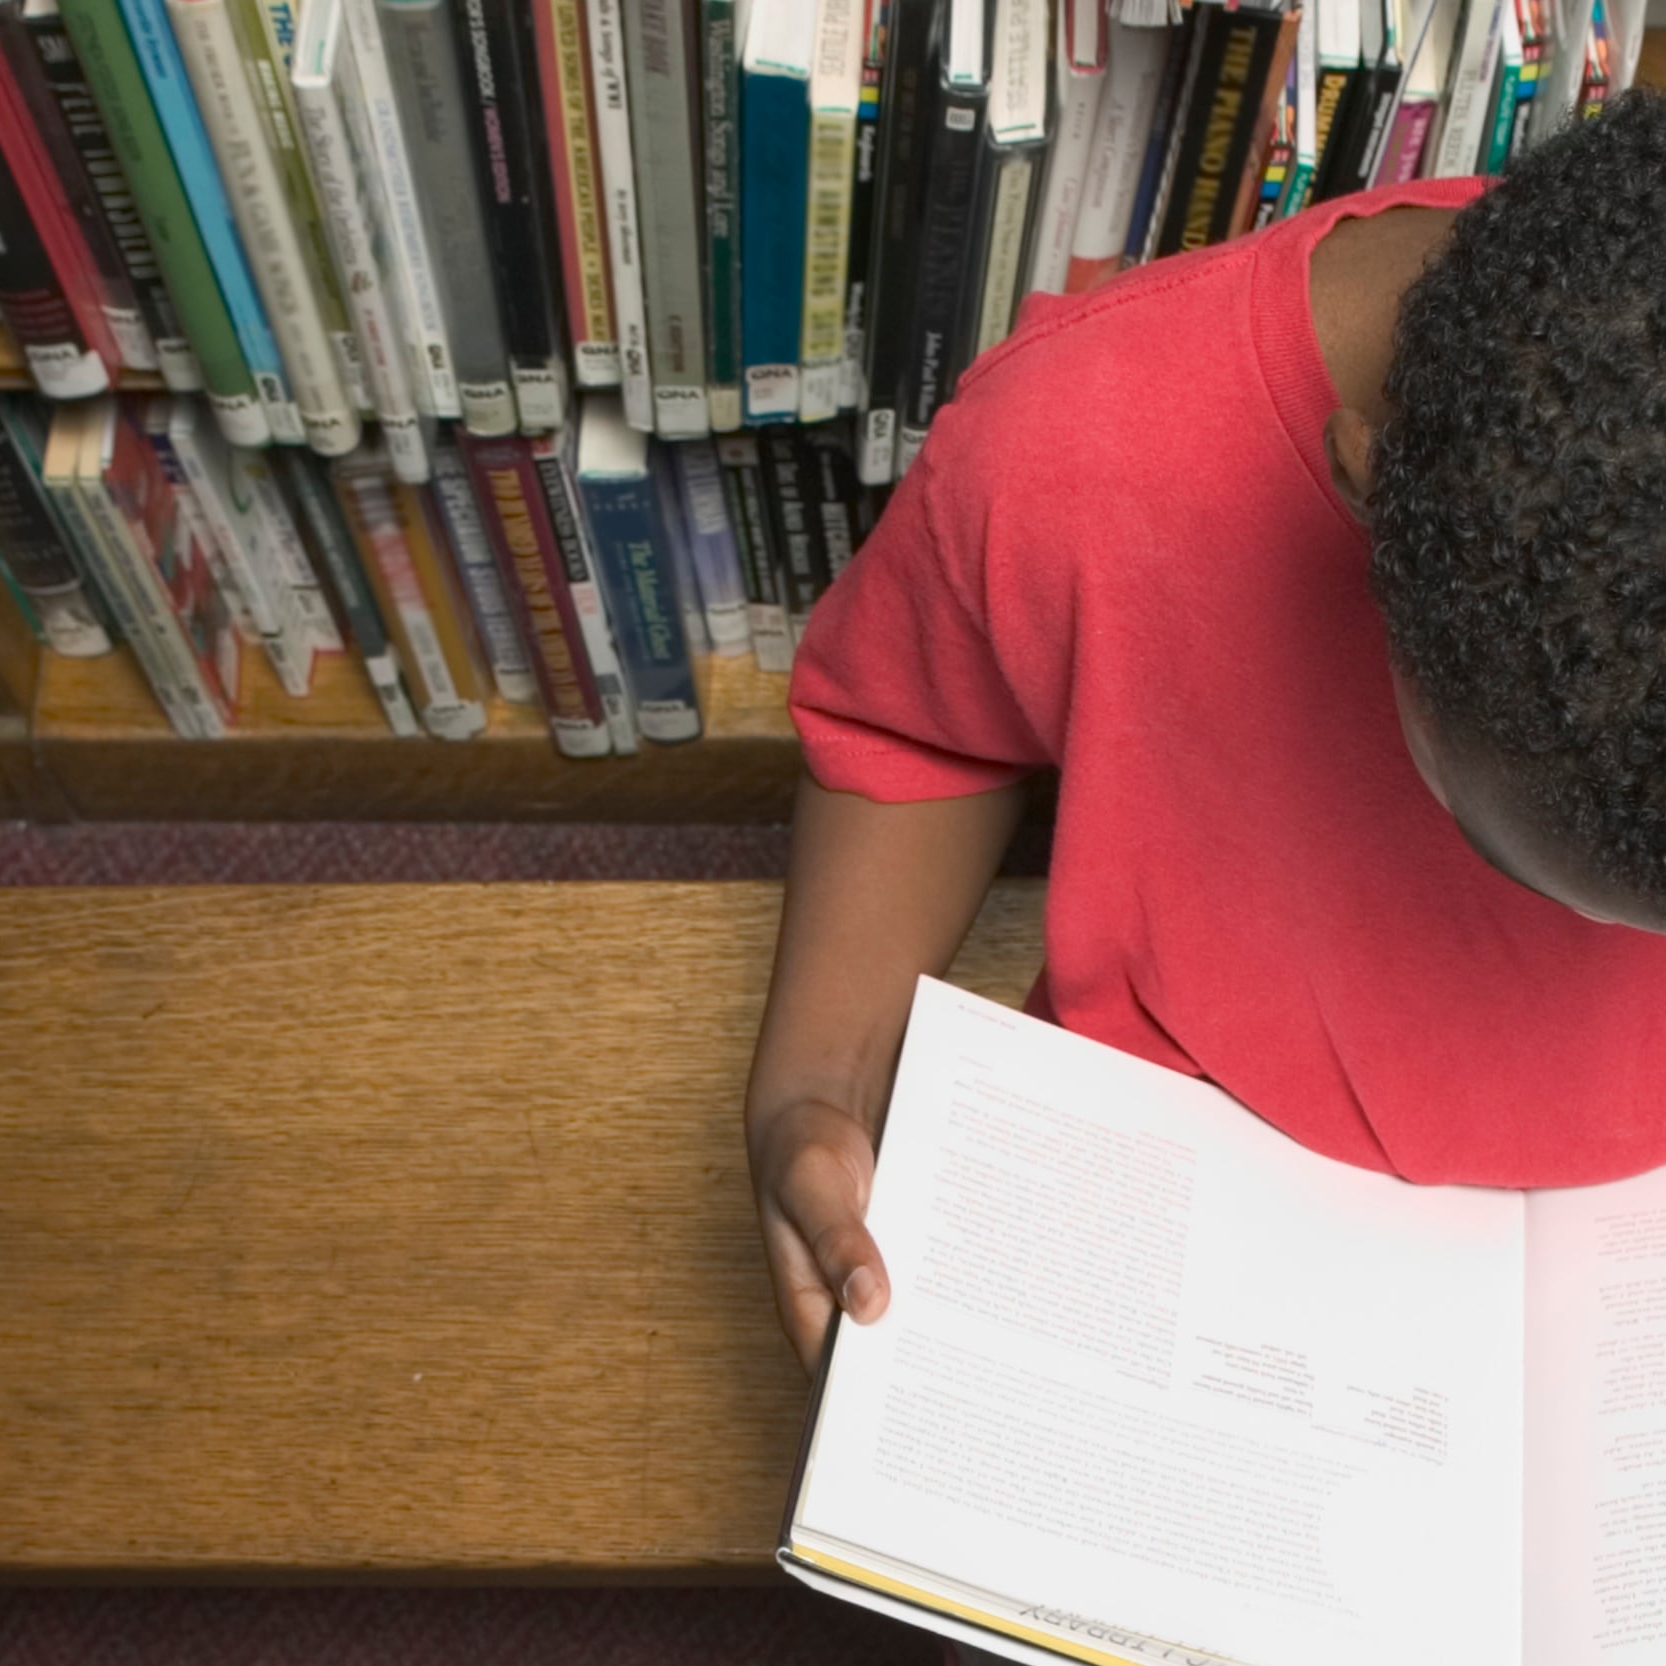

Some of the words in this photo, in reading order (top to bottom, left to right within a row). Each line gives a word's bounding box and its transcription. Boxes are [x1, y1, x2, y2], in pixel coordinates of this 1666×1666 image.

[266, 6, 302, 46] THE
[1217, 27, 1257, 79] THE
[470, 30, 495, 98] SONGBOOK
[559, 49, 583, 92] SONGS
[702, 20, 733, 116] Washington
[706, 123, 733, 167] Songs
[816, 124, 844, 183] LOUIS
[854, 124, 876, 184] Keyboards
[1197, 89, 1242, 171] PIANO
[707, 172, 732, 202] and
[1178, 178, 1221, 249] HAND
[707, 205, 734, 241] Lore
[811, 191, 843, 301] ARMSTRONG
[625, 539, 655, 566] The
[631, 565, 669, 624] Material
[647, 622, 677, 661] Ghost
